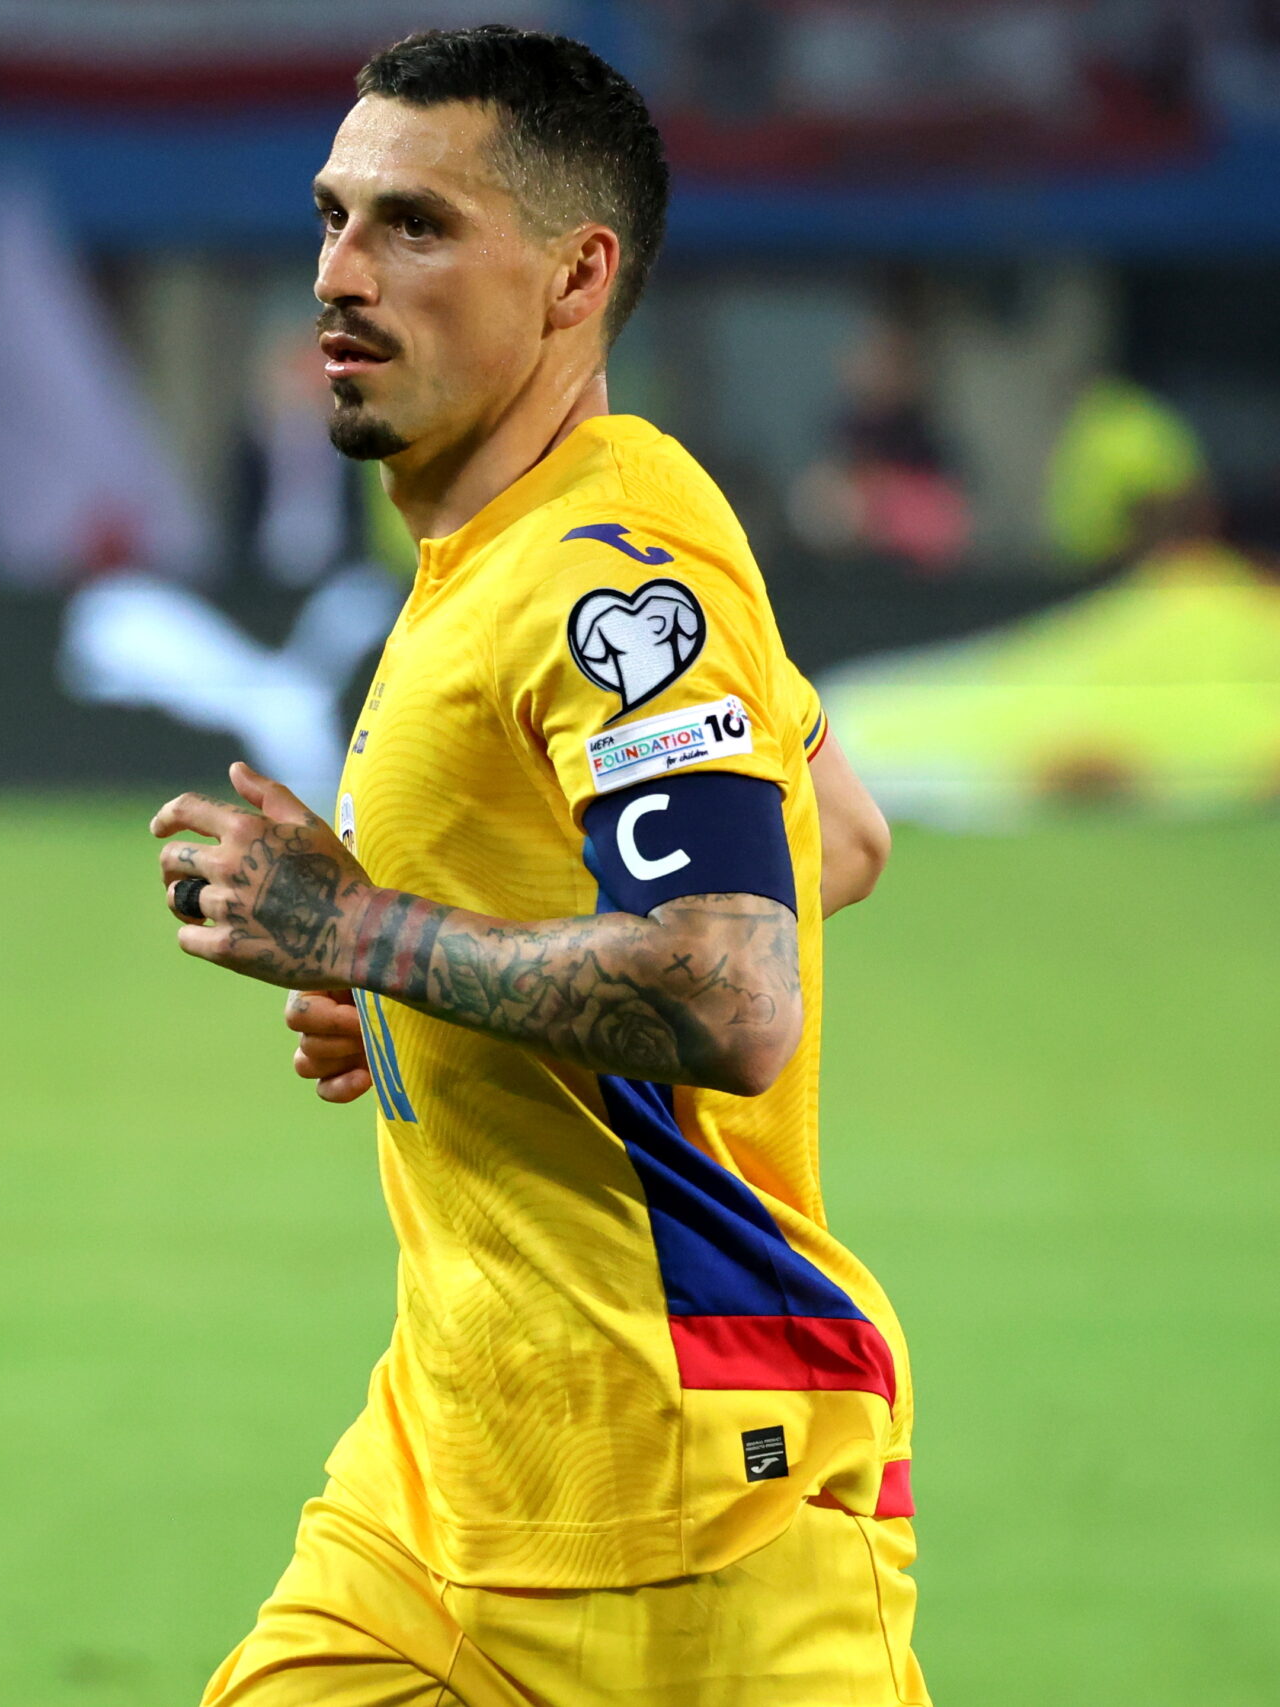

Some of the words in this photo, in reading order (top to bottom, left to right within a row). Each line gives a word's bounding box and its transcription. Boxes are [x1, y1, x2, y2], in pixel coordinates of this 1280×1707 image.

[704, 712, 745, 743] 10
[590, 736, 615, 752] UEFA
[666, 756, 678, 768] for
[679, 750, 709, 763] children
[616, 793, 692, 881] C
